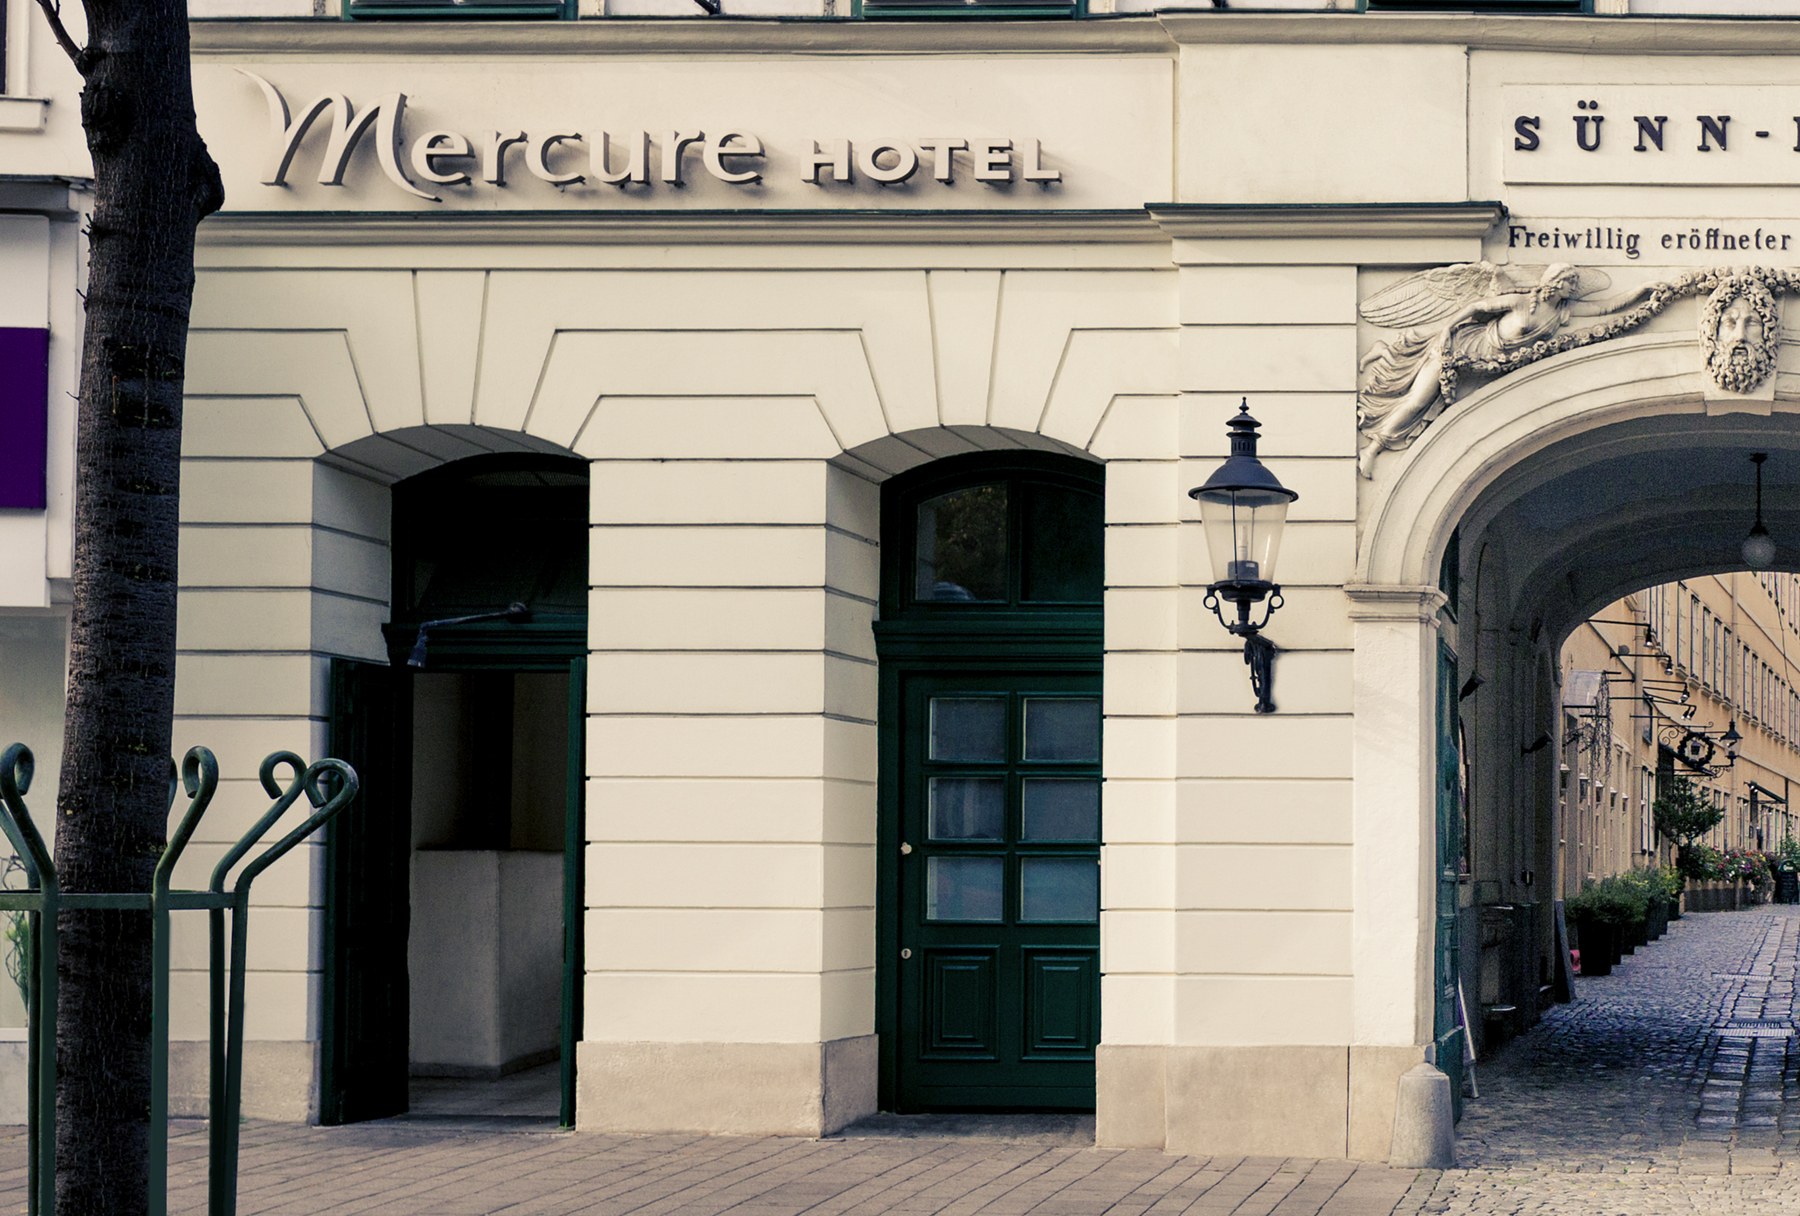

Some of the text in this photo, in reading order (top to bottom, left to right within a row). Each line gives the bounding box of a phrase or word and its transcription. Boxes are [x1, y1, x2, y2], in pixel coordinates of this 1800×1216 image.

[234, 68, 1063, 203] Mercure HOTEL
[1508, 224, 1641, 260] Freiwillig
[1660, 226, 1792, 251] eröffneter
